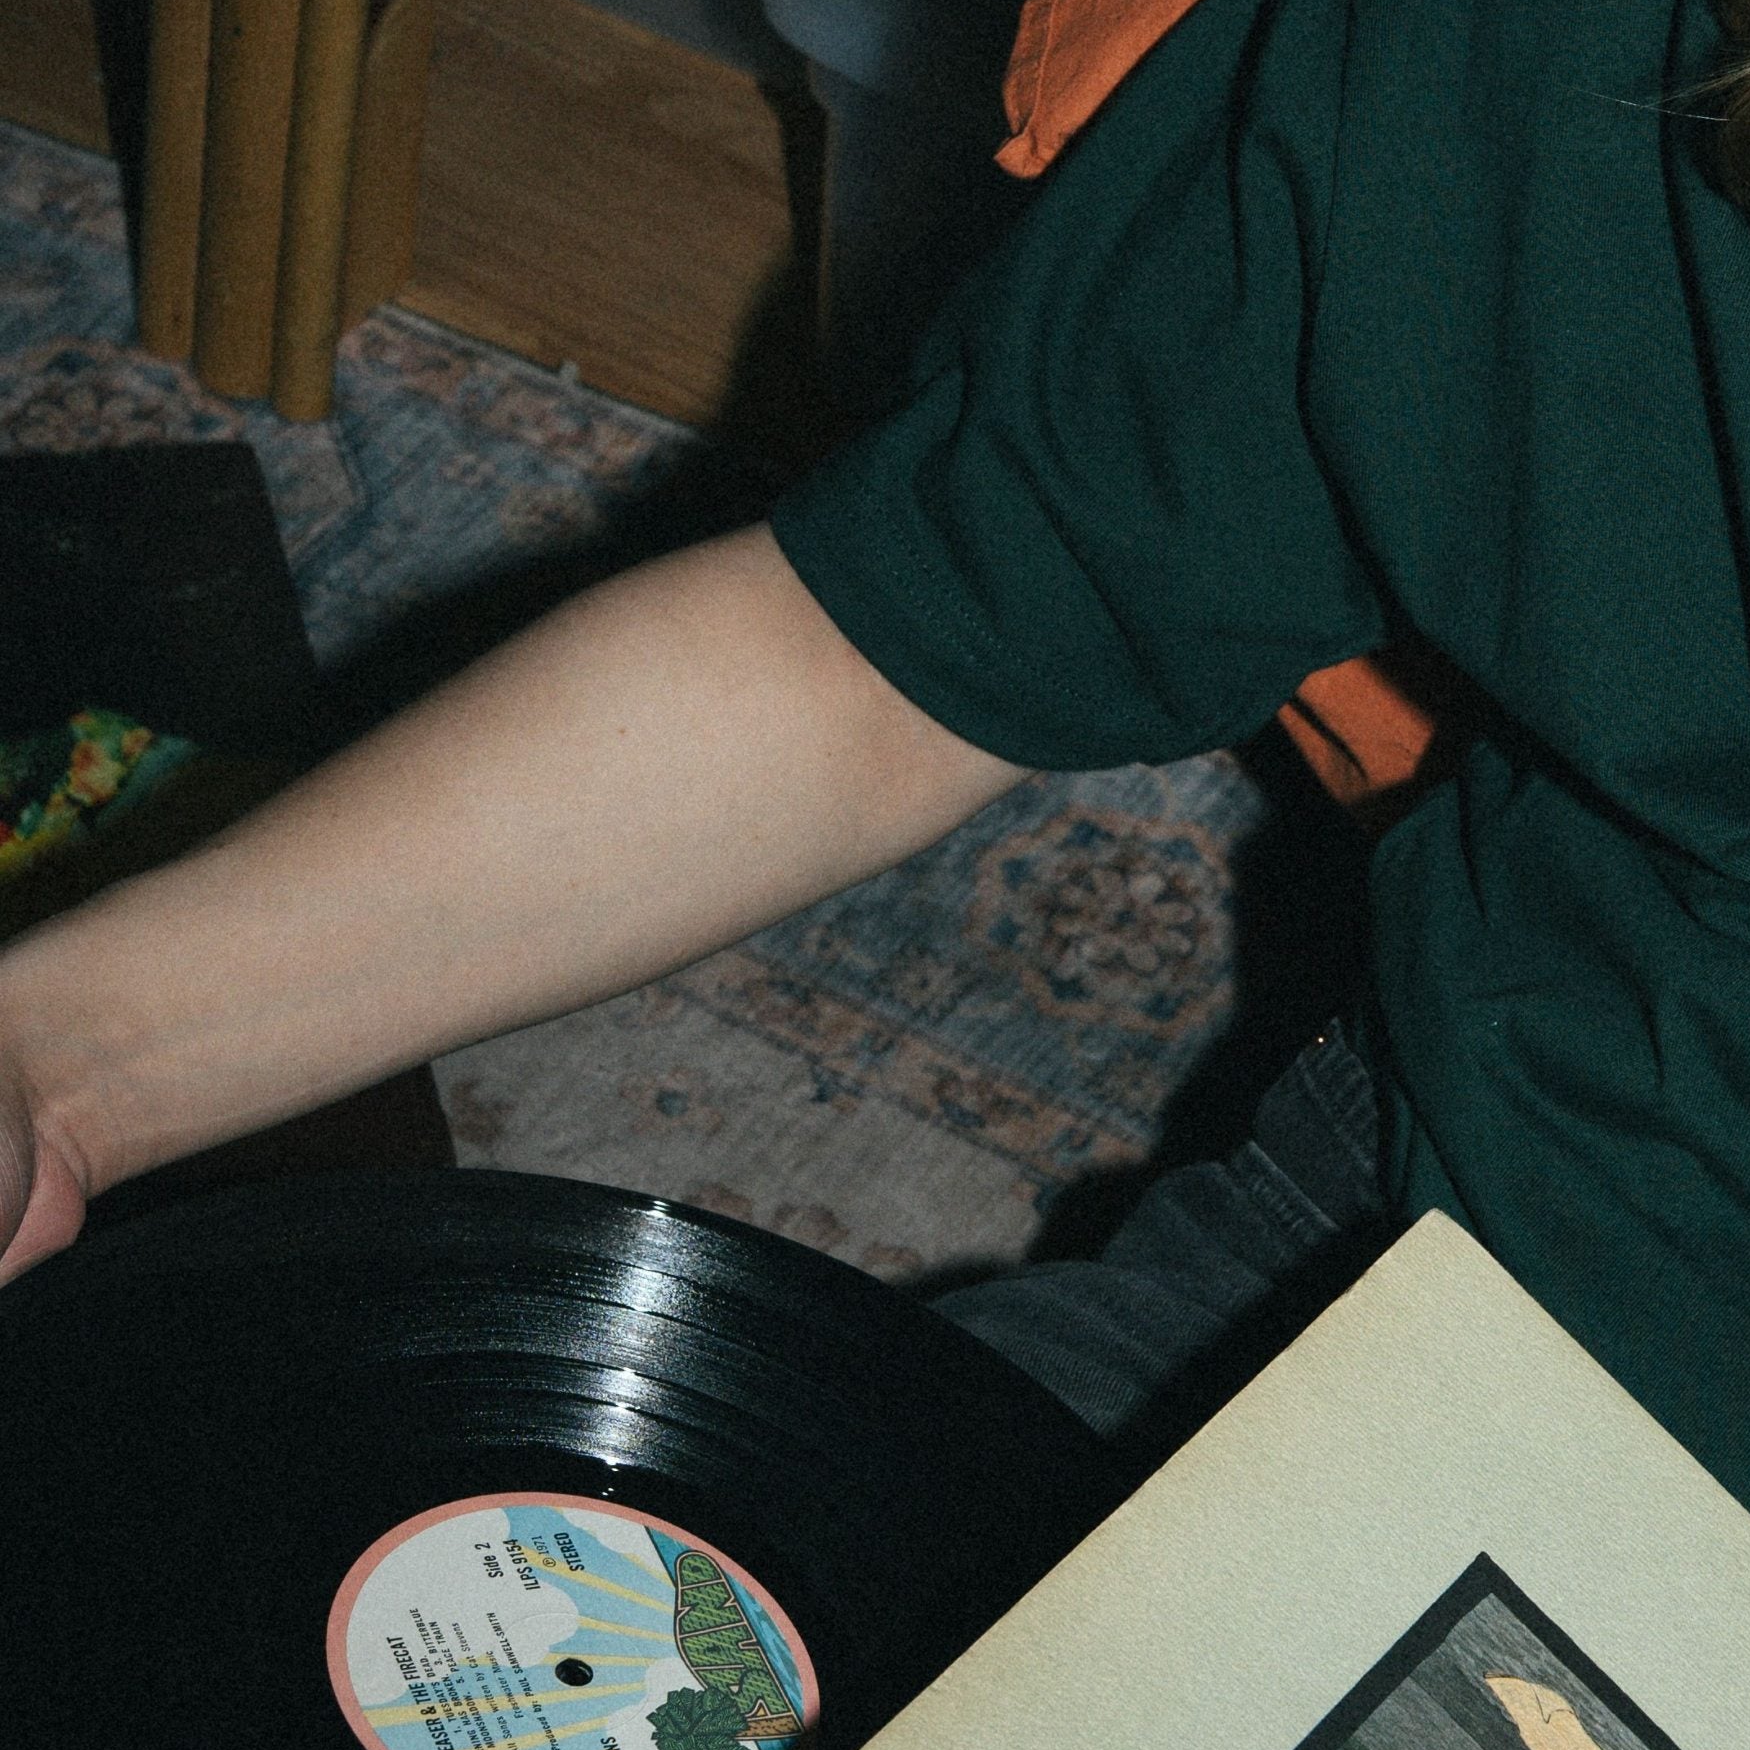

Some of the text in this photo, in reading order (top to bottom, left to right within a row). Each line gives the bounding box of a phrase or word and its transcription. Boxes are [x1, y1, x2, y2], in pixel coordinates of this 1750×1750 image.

[532, 1536, 549, 1555] 1971
[554, 1532, 584, 1572] STEREO
[474, 1542, 504, 1578] Side 2
[502, 1539, 541, 1590] ILPS 9154
[409, 1608, 437, 1654] BITTERBLUE
[428, 1622, 446, 1645] TRAIN
[452, 1622, 470, 1652] Stevens
[486, 1612, 523, 1674] SAMWELL-SMITH
[386, 1637, 420, 1680] FIRECAT
[434, 1658, 442, 1666] 3.
[441, 1648, 459, 1672] PEACE
[466, 1655, 478, 1668] Cat
[442, 1674, 462, 1706] BROKEN.
[456, 1676, 464, 1684] 5.
[475, 1673, 484, 1682] by
[486, 1650, 524, 1718] Freshwater Music
[518, 1678, 534, 1697] PAUL
[408, 1682, 431, 1705] THE
[420, 1655, 462, 1734] 1. TUESDAY'S DEAD.
[481, 1685, 499, 1713] written
[420, 1706, 436, 1715] &
[458, 1711, 471, 1726] HAS
[463, 1691, 495, 1748] MOONSHADOW.
[497, 1716, 512, 1739] Songs
